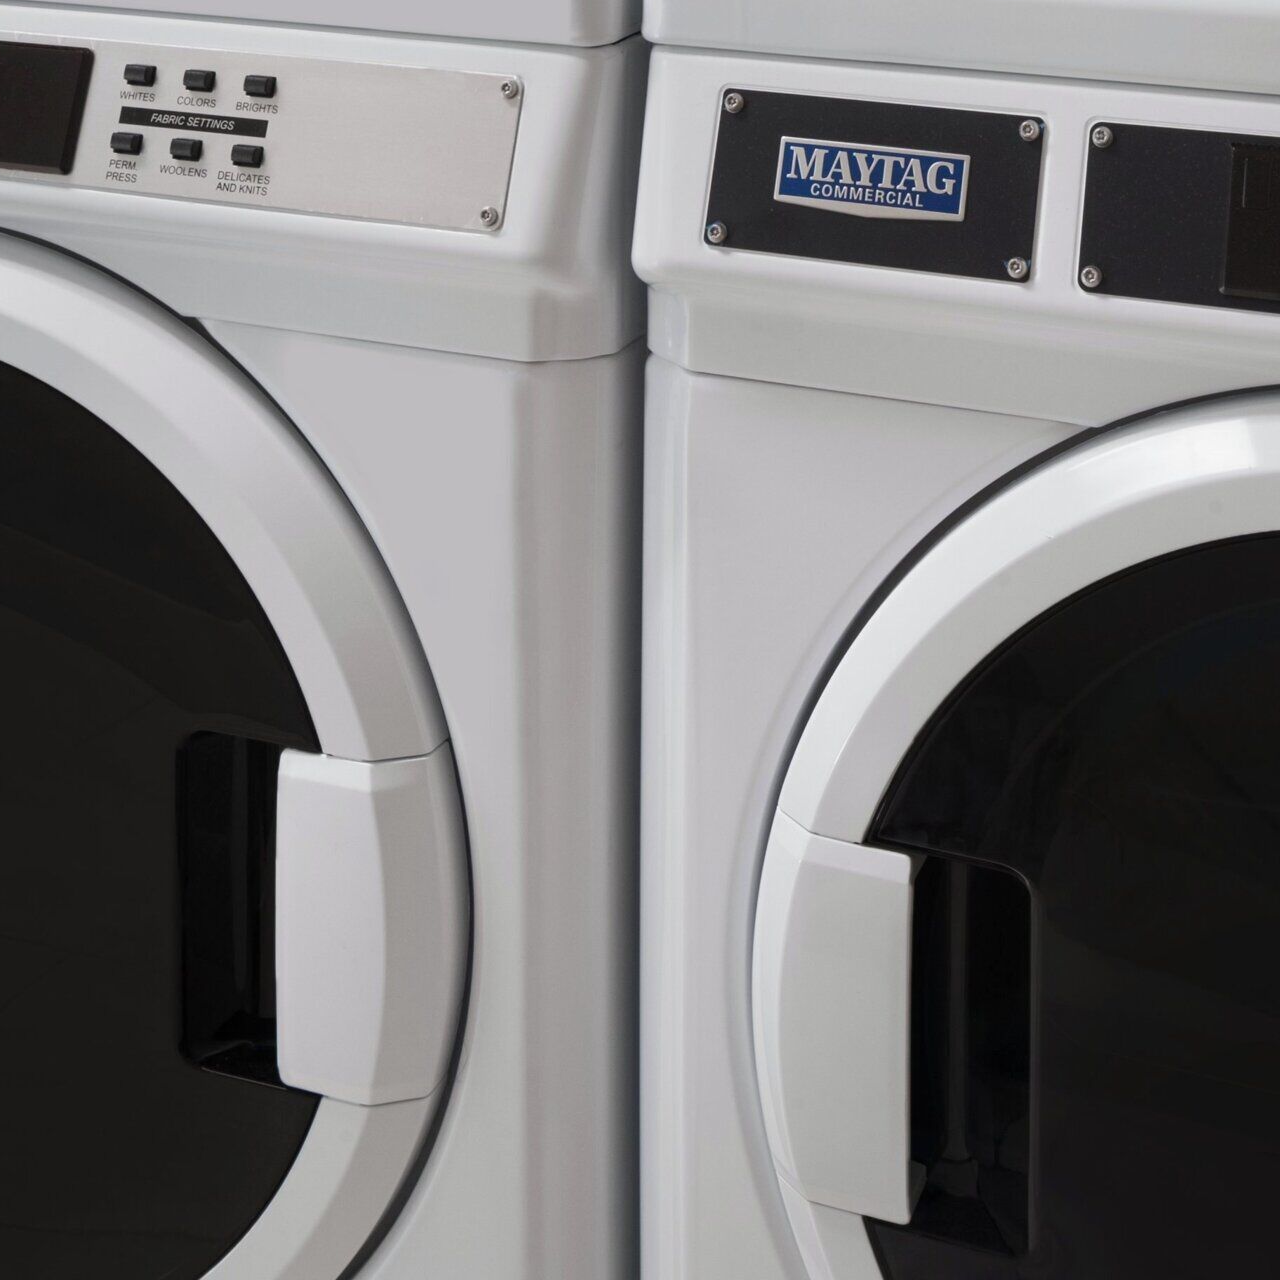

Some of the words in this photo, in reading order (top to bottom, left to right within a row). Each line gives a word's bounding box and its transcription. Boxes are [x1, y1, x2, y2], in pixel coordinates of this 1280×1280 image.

[120, 91, 156, 103] WHITES
[177, 95, 217, 109] COLORS
[235, 101, 279, 114] BRIGHTS
[150, 112, 185, 126] FABRIC
[186, 116, 236, 131] SETTINGS
[109, 159, 138, 171] PERM.
[160, 164, 208, 178] WOOLENS
[786, 145, 957, 195] MAYTAG
[105, 172, 138, 183] PRESS
[217, 170, 271, 185] DELICATES
[216, 182, 237, 193] AND
[238, 184, 269, 197] KNITS
[810, 182, 924, 208] COMMERCIAL
